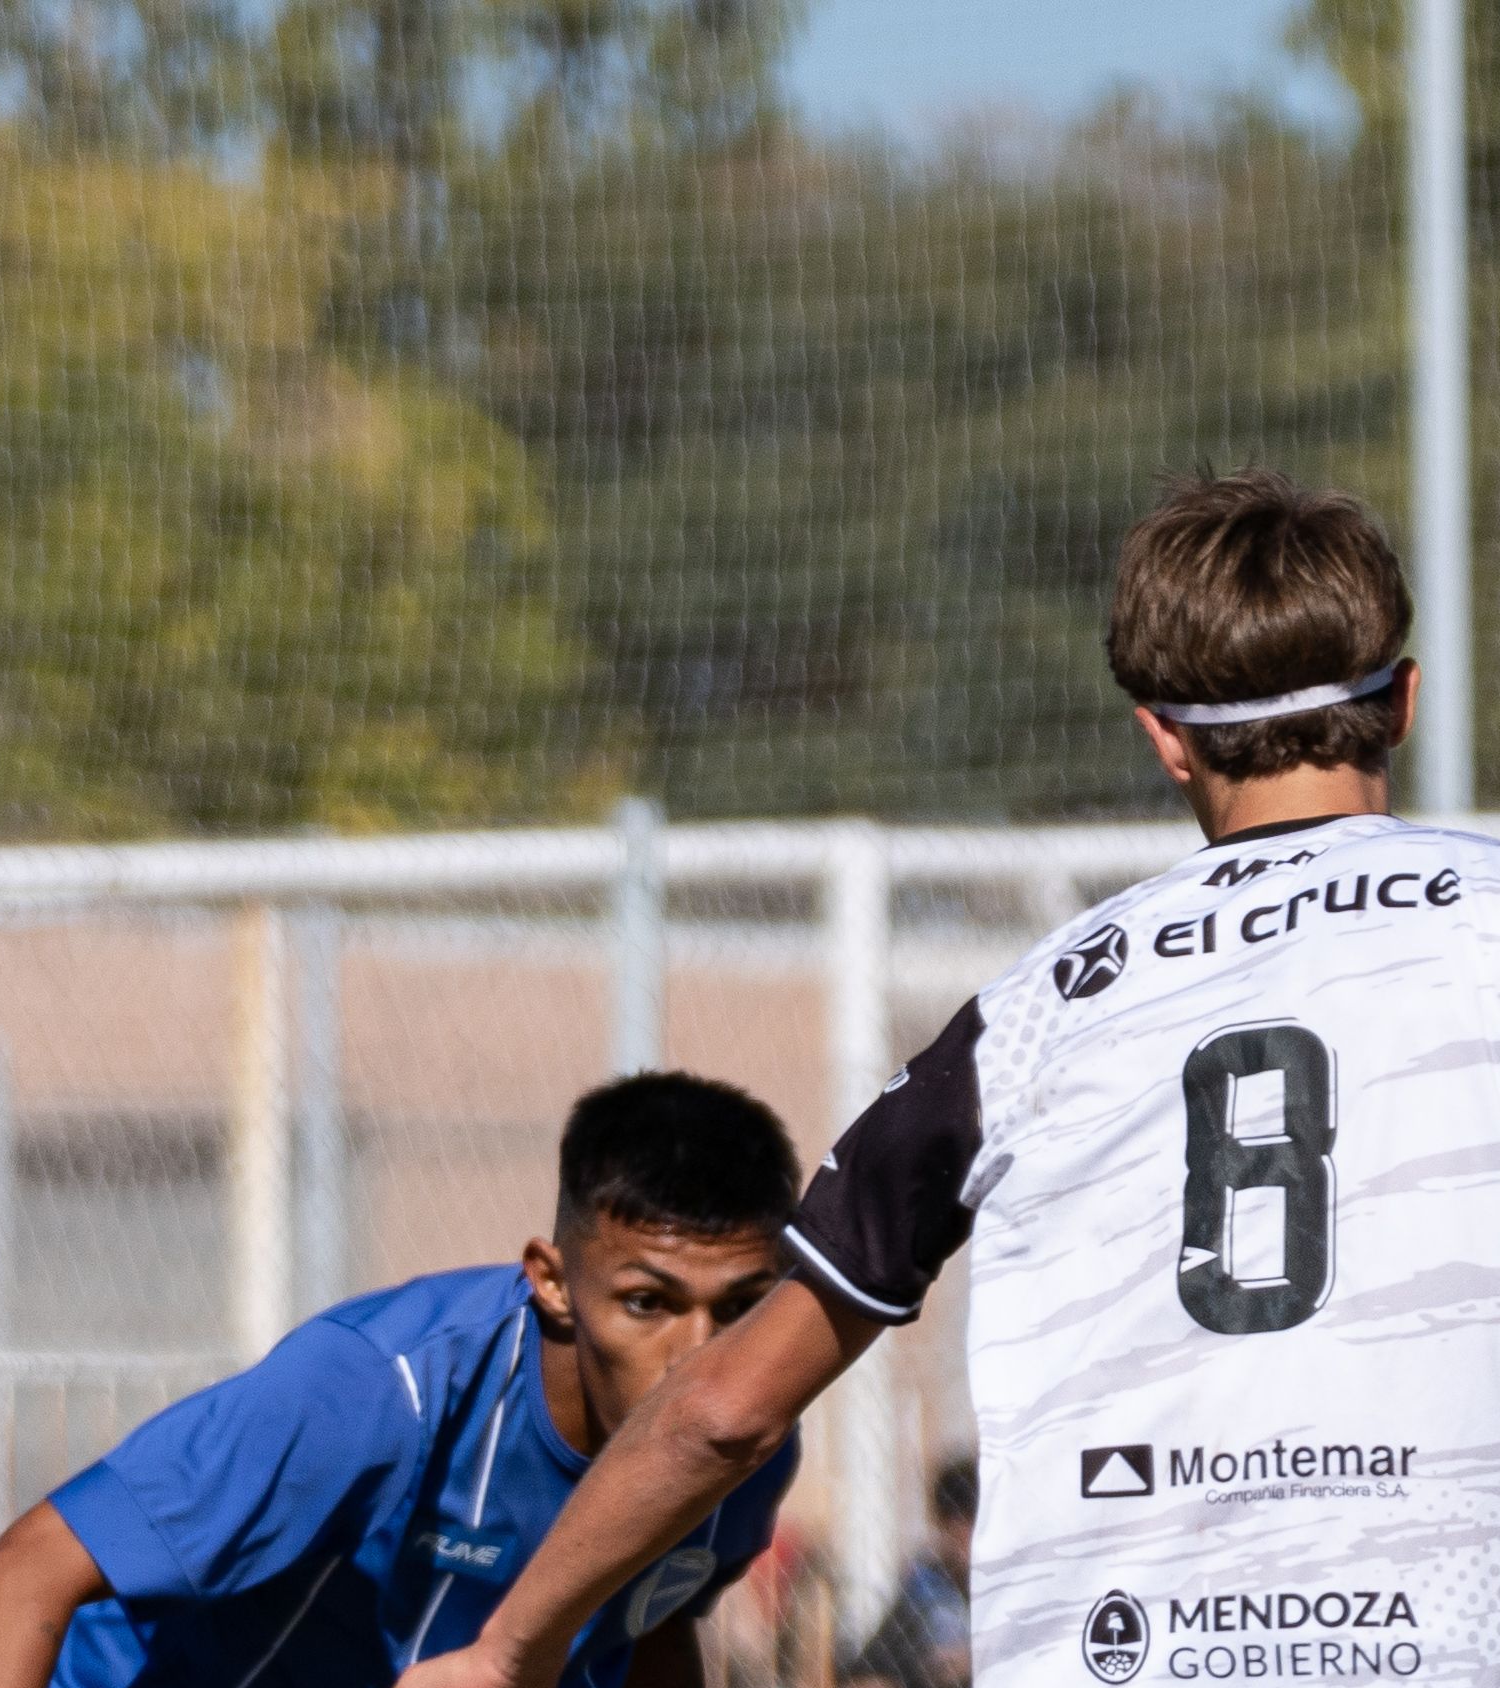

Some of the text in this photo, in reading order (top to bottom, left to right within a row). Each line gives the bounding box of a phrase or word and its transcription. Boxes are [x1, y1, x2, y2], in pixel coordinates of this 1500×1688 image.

[1177, 1017, 1338, 1335] 8
[1169, 1439, 1418, 1487] Montemar
[1289, 1481, 1371, 1499] Financiera
[1169, 1591, 1419, 1634] MENDOZA
[1168, 1642, 1422, 1680] GOBIERNO
